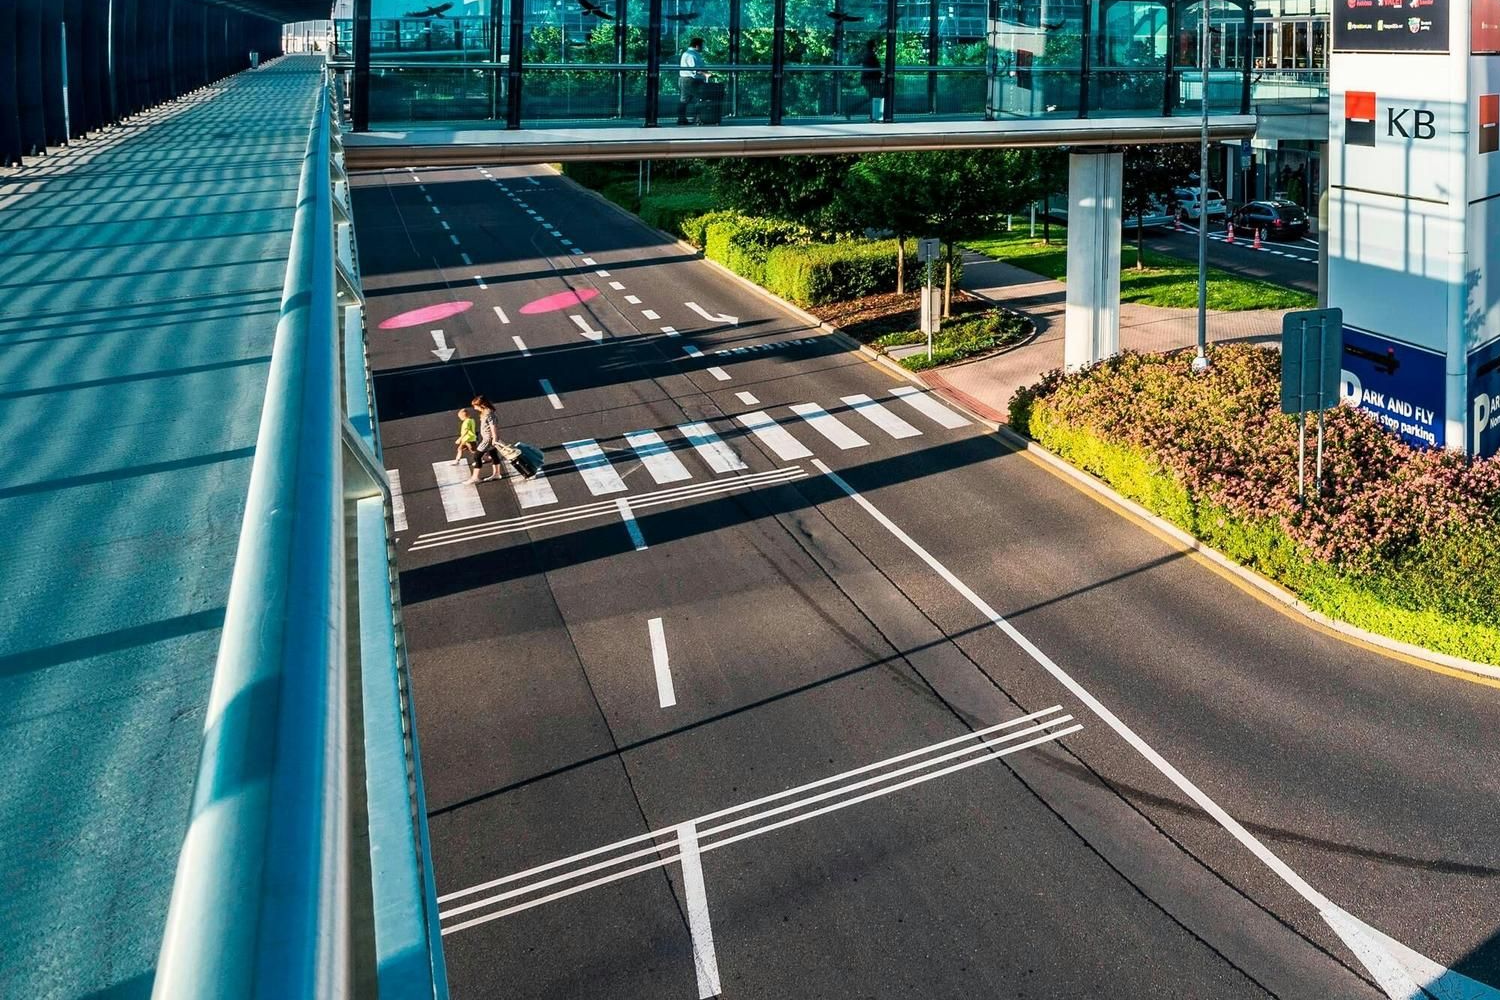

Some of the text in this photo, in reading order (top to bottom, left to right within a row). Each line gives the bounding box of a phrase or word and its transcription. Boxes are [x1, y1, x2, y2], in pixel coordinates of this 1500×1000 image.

[1387, 107, 1436, 140] KB
[1387, 397, 1413, 418] AND
[1415, 406, 1435, 426] FLY
[1489, 417, 1500, 430] Non
[1380, 414, 1400, 430] stop
[1401, 421, 1435, 446] parking
